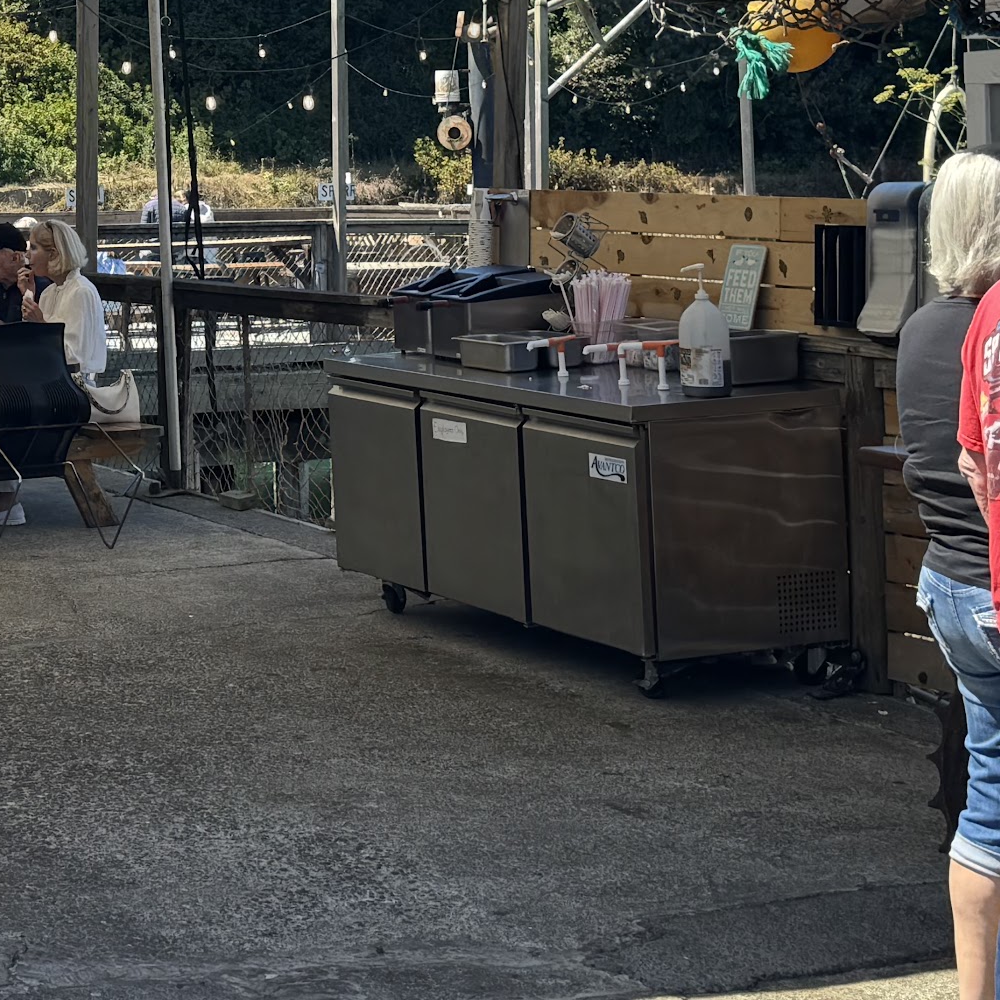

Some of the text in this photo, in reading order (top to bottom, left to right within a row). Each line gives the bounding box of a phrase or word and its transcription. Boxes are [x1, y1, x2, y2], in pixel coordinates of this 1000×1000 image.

[725, 269, 757, 288] FEED
[724, 288, 754, 305] THEM
[722, 313, 749, 325] OME
[591, 456, 626, 478] AVANTCO
